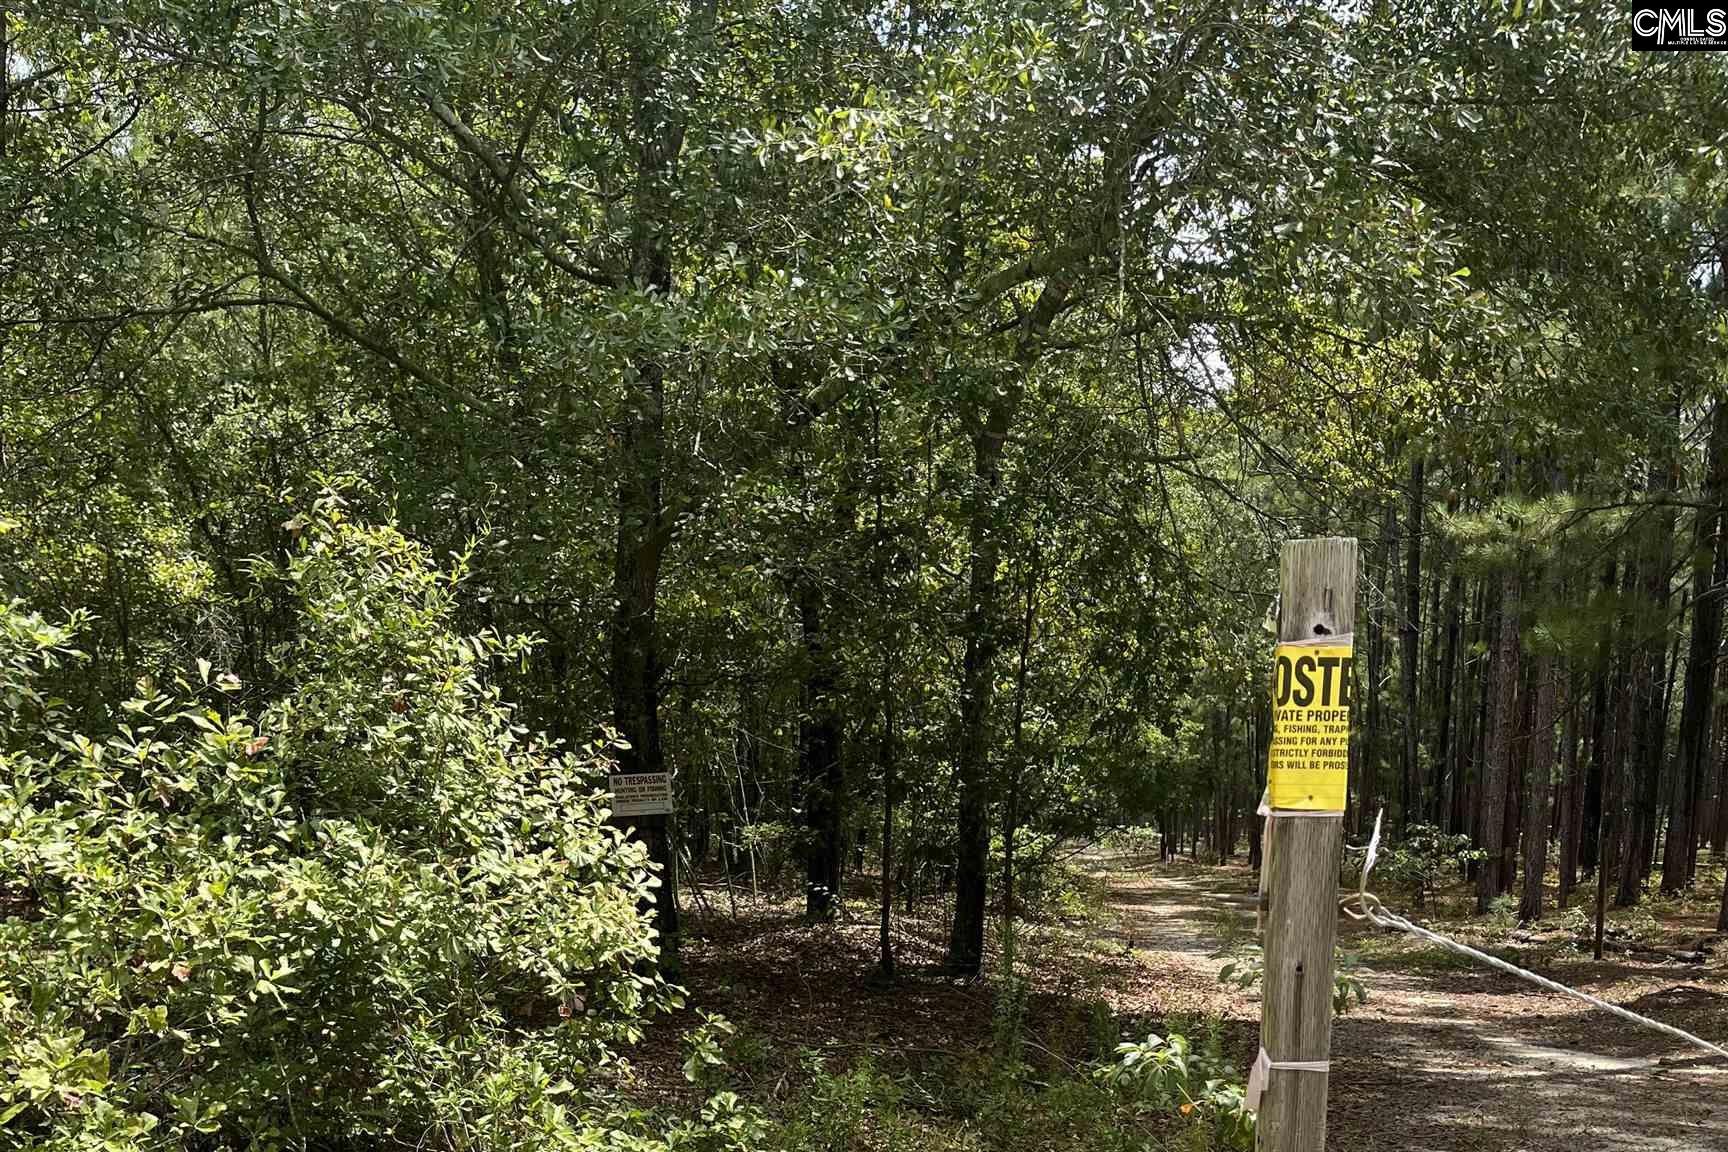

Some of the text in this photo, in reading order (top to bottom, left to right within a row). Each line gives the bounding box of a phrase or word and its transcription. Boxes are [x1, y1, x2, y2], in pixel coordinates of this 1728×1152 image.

[1307, 710, 1347, 721] PROPE
[1283, 725, 1320, 735] FISHING,
[1300, 737, 1317, 745] FOR
[1320, 737, 1337, 745] ANY
[1287, 761, 1306, 769] WILL
[1309, 761, 1321, 769] BE
[613, 775, 667, 785] NO TRESPASSING
